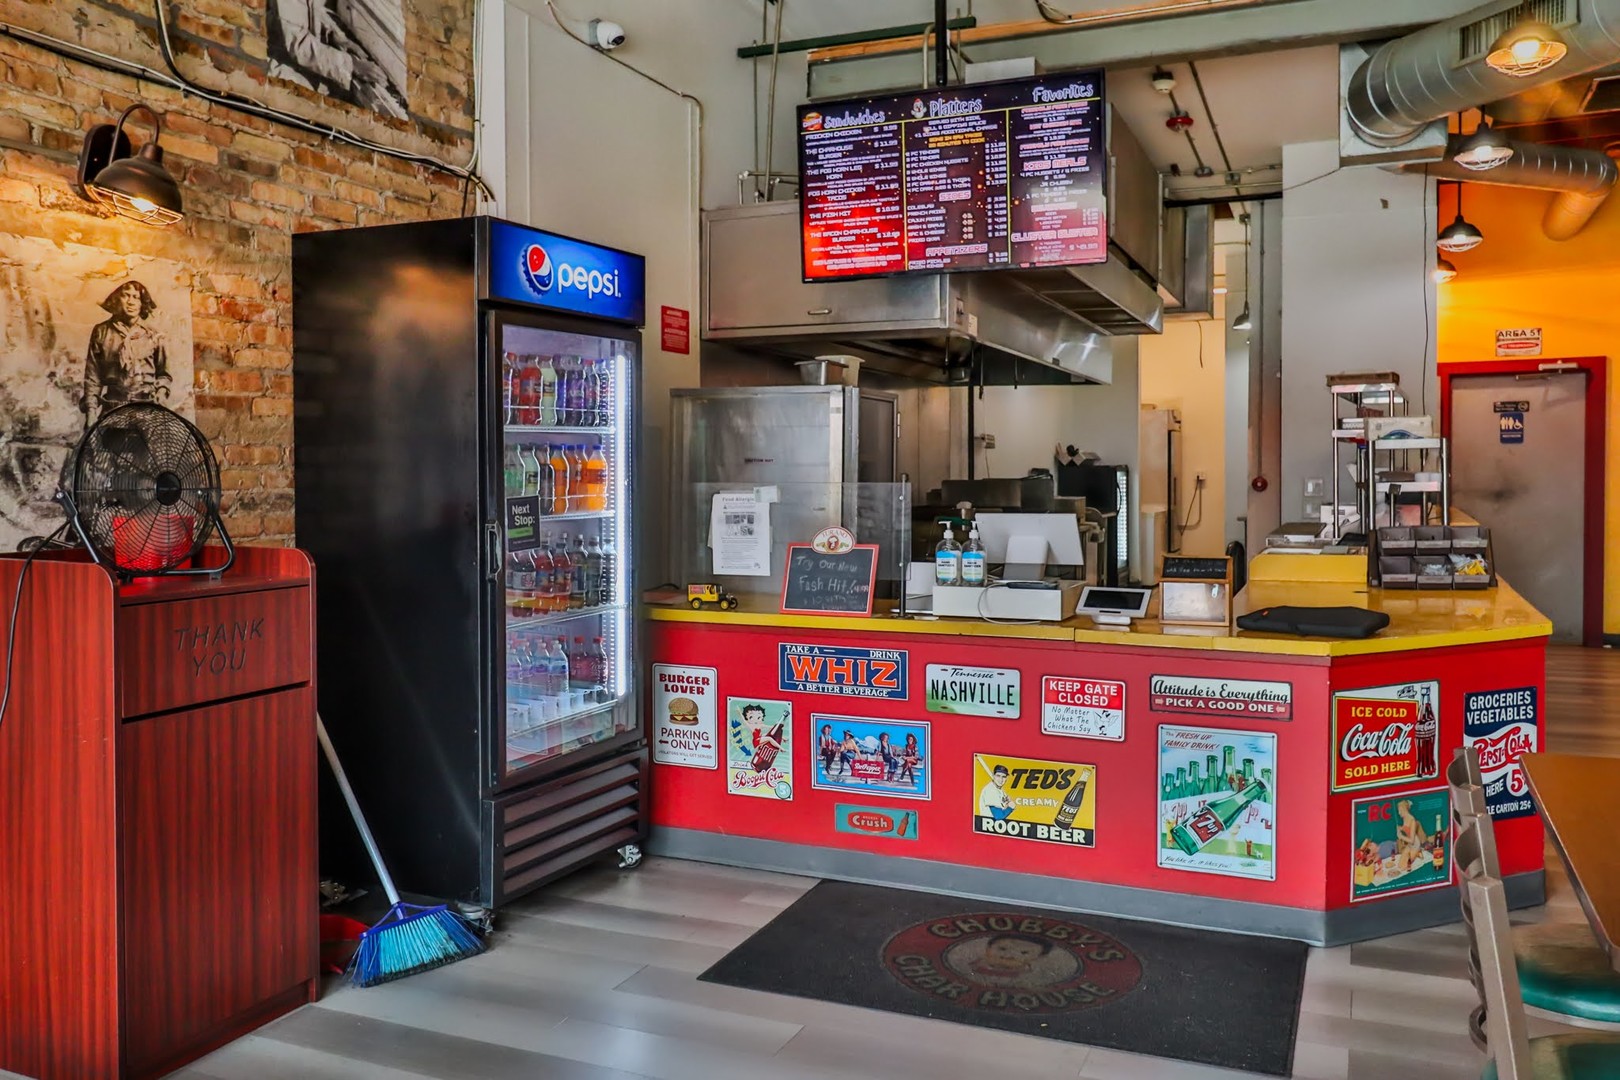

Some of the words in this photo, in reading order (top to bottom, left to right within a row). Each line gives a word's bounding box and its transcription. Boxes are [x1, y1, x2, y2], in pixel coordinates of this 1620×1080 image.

[1032, 84, 1093, 102] Favorites
[930, 98, 982, 117] Platters
[824, 108, 886, 128] Sandwiches
[1052, 156, 1087, 168] MEALS
[939, 190, 971, 201] SIDES
[926, 243, 988, 257] APPETIZERS
[558, 263, 619, 299] pepsi
[512, 504, 530, 515] Next
[515, 515, 535, 526] Stop:
[796, 556, 814, 571] Try
[820, 560, 835, 570] Our
[175, 617, 264, 651] THANK
[785, 644, 810, 654] TAKE
[812, 645, 820, 654] A
[870, 650, 900, 659] DRINK
[193, 647, 246, 677] YOU
[788, 654, 898, 688] WHIZ
[950, 668, 994, 679] Tennessee
[659, 673, 710, 686] BURGER
[664, 684, 705, 695] LOVER
[806, 683, 840, 694] BETTER
[843, 686, 889, 697] BEVERAGE
[931, 679, 1015, 706] NASHVILLE
[1049, 680, 1080, 693] KEEP
[1084, 684, 1117, 696] GATE
[1153, 680, 1203, 696] Attitude
[1206, 687, 1216, 697] is
[1219, 683, 1288, 703] Everything
[1058, 692, 1108, 707] CLOSED
[1166, 698, 1193, 707] PICK
[1196, 700, 1205, 708] A
[1208, 700, 1245, 710] GOOD
[1248, 703, 1274, 712] ONE
[1470, 691, 1531, 710] GROCERIES
[1064, 707, 1090, 715] Matter
[1351, 707, 1372, 717] ICE
[1376, 708, 1407, 717] COLD
[1467, 705, 1534, 725] VEGETABLES
[1054, 714, 1073, 723] What
[1077, 716, 1089, 724] The
[661, 727, 709, 741] PARKING
[1047, 722, 1076, 732] Chickens
[1079, 724, 1091, 733] Say
[1175, 732, 1200, 740] FRESH
[1341, 723, 1413, 761] Coca-Cola
[670, 740, 700, 750] ONLY
[1191, 741, 1220, 750] DRINK!
[1345, 764, 1379, 778] SOLD
[1381, 760, 1410, 773] HERE
[1010, 768, 1076, 790] TED'S
[1486, 778, 1504, 797] HERE
[1015, 798, 1058, 807] CREAMY
[1496, 802, 1519, 814] CARTON
[1520, 800, 1531, 810] 25¢
[1367, 803, 1392, 822] RC
[852, 815, 888, 828] Crush
[982, 818, 1030, 836] ROOT
[1037, 824, 1086, 844] BEER
[929, 916, 1125, 962] CHUBBY'S
[894, 955, 972, 998] CHAR
[978, 982, 1114, 1009] HOUSE
